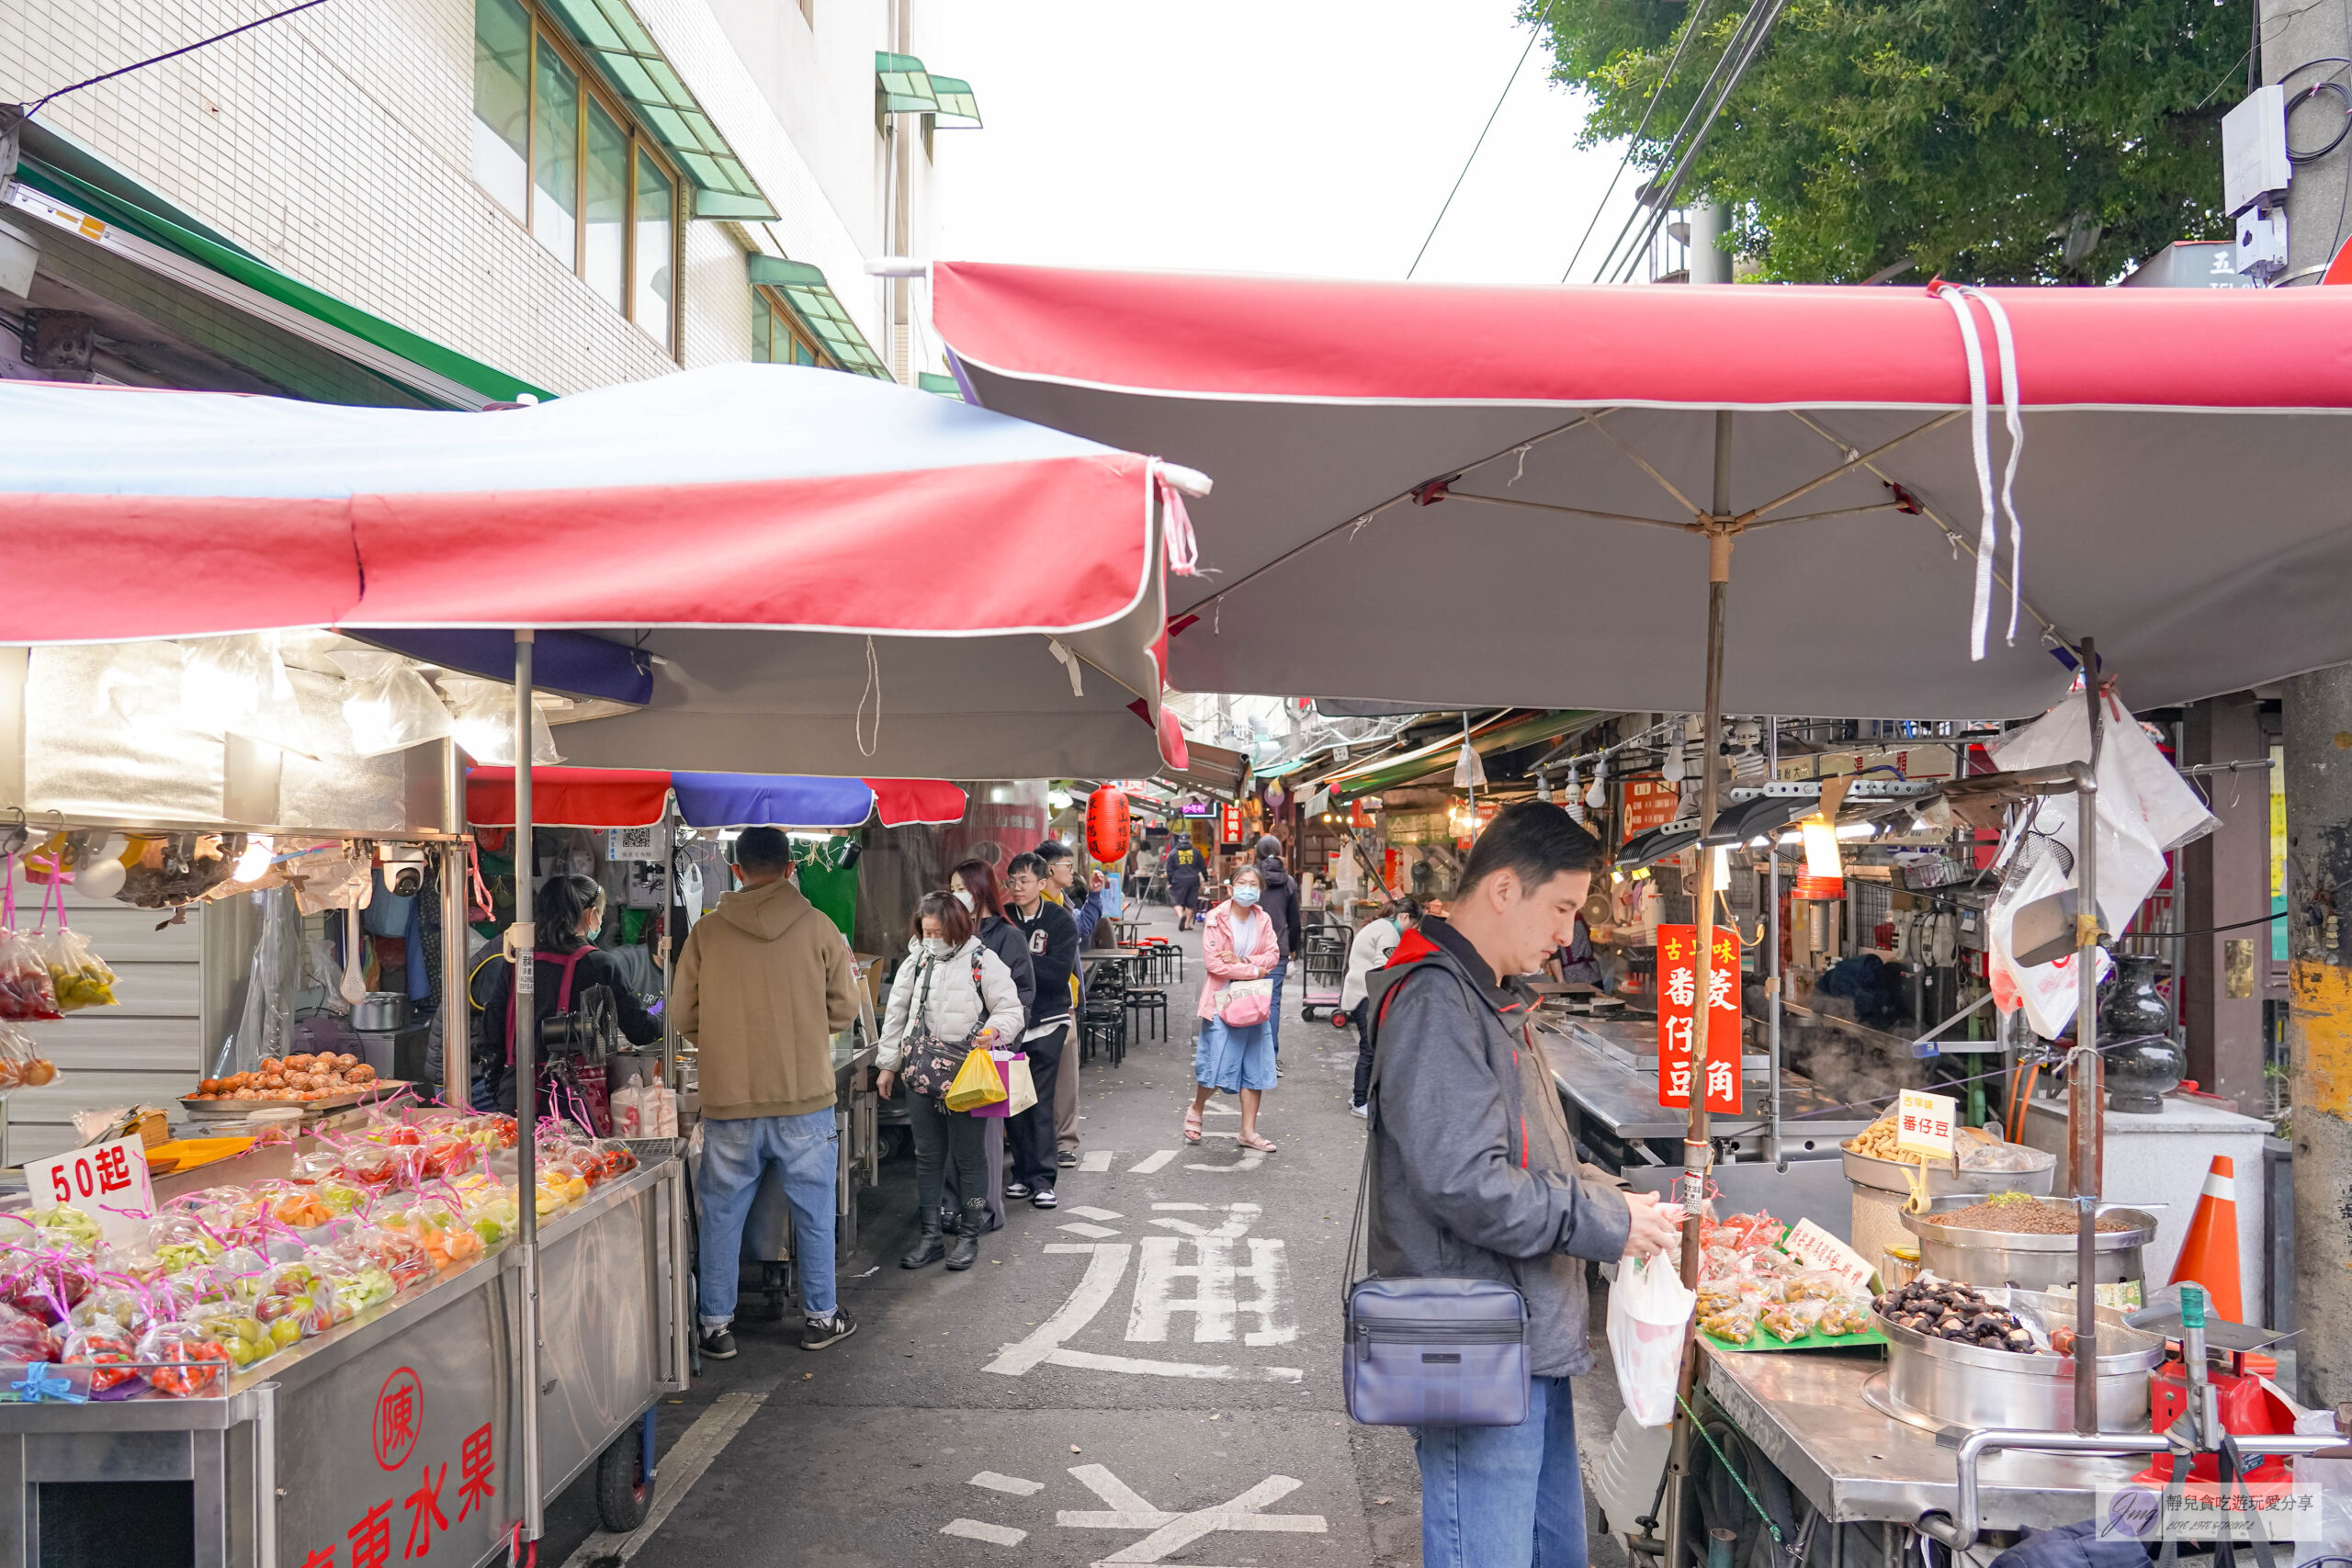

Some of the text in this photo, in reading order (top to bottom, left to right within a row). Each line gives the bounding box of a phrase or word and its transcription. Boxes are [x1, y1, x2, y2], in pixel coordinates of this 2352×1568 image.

[2210, 251, 2235, 275] 五
[1028, 929, 1049, 956] G
[1664, 937, 1737, 964] 古味
[1664, 966, 1695, 1098] 番仔豆
[1705, 968, 1738, 1102] 菱角
[1904, 1096, 1934, 1111] 古早味
[1903, 1115, 1950, 1138] 番仔豆
[381, 1384, 414, 1460] 陳
